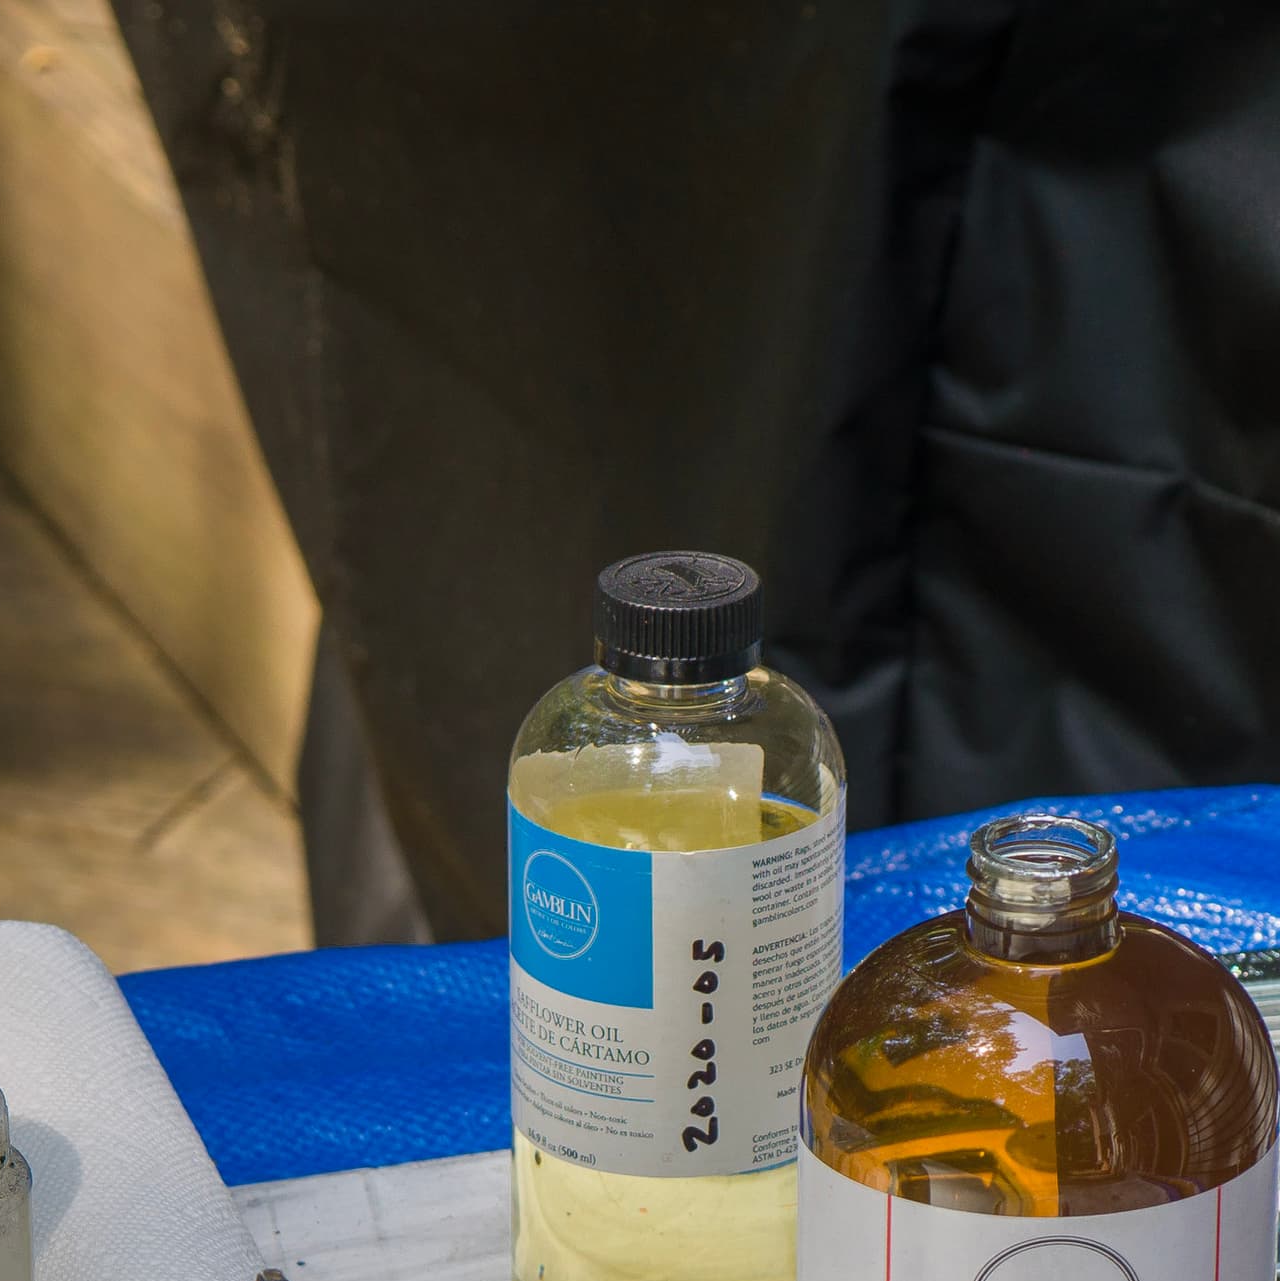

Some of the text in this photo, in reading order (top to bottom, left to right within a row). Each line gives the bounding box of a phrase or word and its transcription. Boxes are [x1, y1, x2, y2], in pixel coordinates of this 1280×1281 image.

[752, 850, 793, 868] WARNING:
[752, 870, 771, 880] with
[772, 866, 783, 875] oil
[752, 881, 804, 903] wool or waste
[526, 882, 592, 924] GAMBLIN
[752, 899, 792, 915] container.
[752, 932, 808, 955] ADVERTENCIA:
[752, 951, 788, 967] desechos
[752, 963, 784, 979] generar
[752, 975, 783, 989] manera
[752, 989, 776, 1001] acero
[752, 993, 796, 1012] después de
[759, 1006, 792, 1022] lleno de
[752, 1015, 799, 1034] los datos de
[591, 1024, 624, 1043] OIL
[752, 1035, 770, 1046] com
[538, 1025, 556, 1046] DE
[559, 1036, 651, 1066] CÁRTAMO
[682, 939, 725, 1152] 2020-05
[576, 1067, 624, 1085] PAINTING
[769, 1063, 783, 1075] 323
[568, 1076, 622, 1096] SOLVENTES
[777, 1086, 797, 1099] Made
[590, 1111, 628, 1124] Non-toxic
[605, 1126, 618, 1136] No
[752, 1127, 789, 1143] Conforms
[752, 1139, 790, 1153] Conforme
[580, 1153, 596, 1166] ml)
[752, 1152, 774, 1164] ASTM
